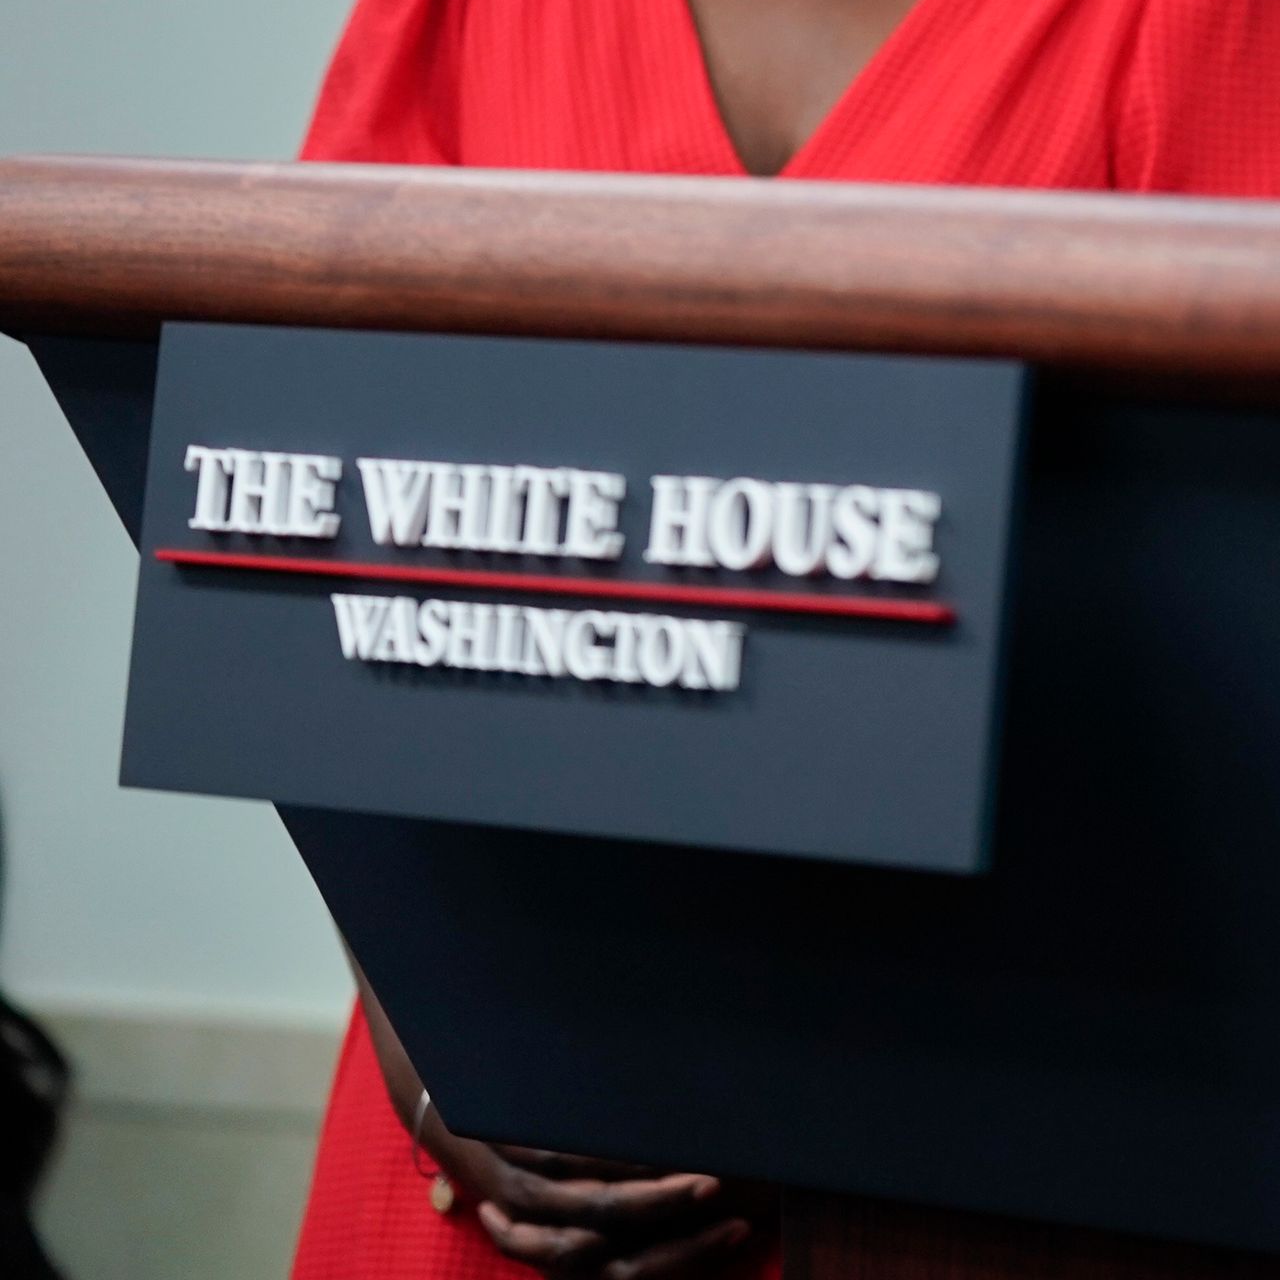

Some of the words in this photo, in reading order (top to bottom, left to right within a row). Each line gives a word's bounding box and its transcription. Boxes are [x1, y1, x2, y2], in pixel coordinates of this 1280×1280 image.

[184, 445, 343, 538] THE
[356, 457, 626, 559] WHITE
[644, 473, 941, 582] HOUSE
[331, 592, 744, 691] WASHINGTON
